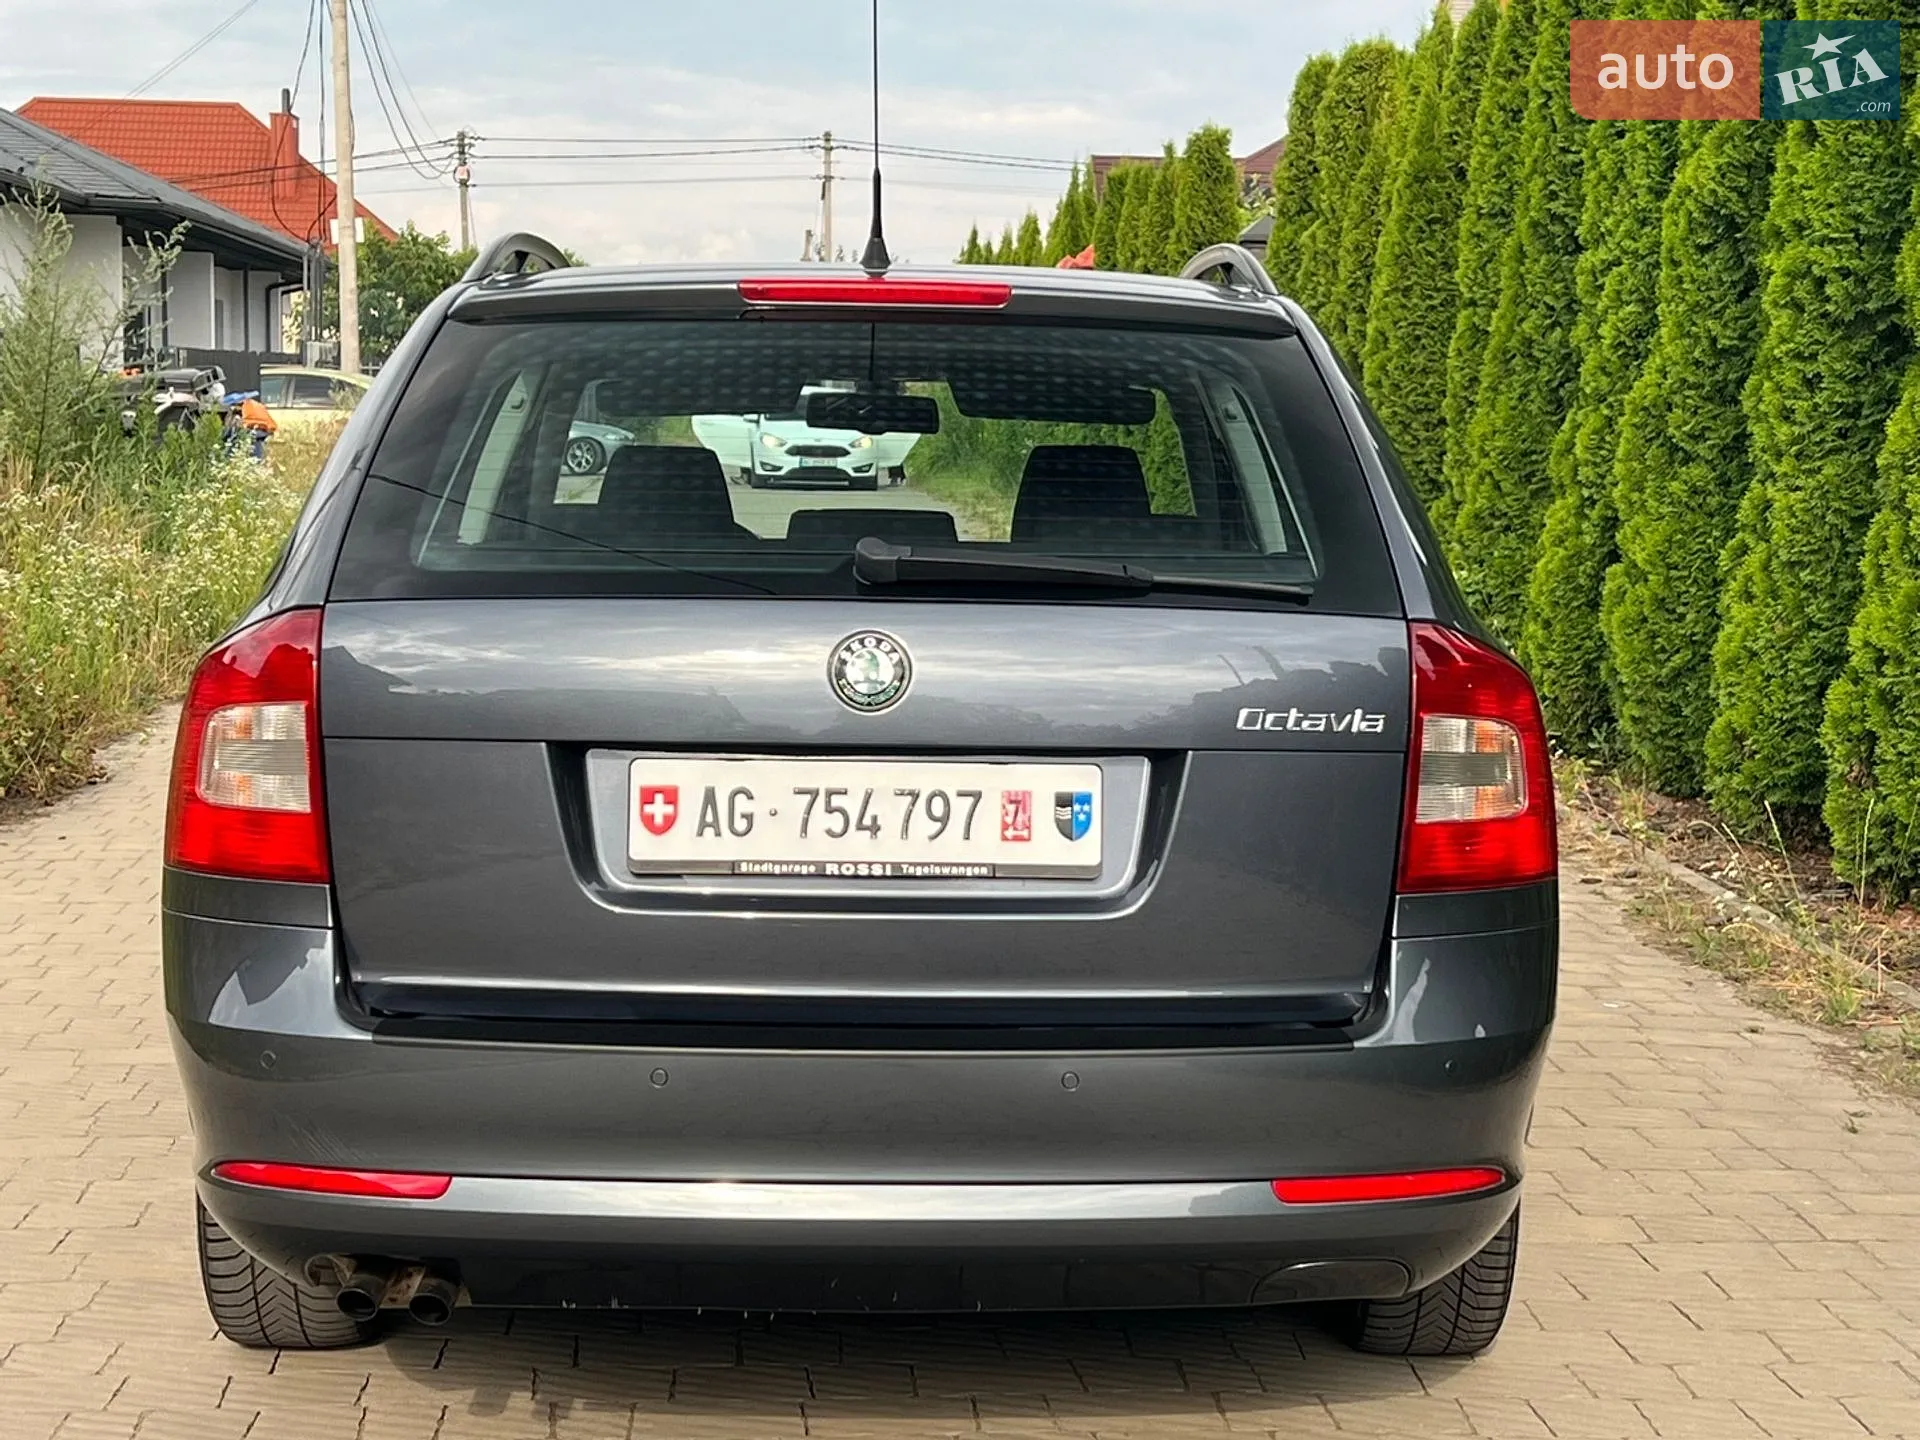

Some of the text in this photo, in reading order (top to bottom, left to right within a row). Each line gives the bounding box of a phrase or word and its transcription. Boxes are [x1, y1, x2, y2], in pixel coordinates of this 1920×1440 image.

[1236, 707, 1387, 733] Octavia
[893, 788, 983, 841] 797
[825, 863, 892, 876] ROSSI
